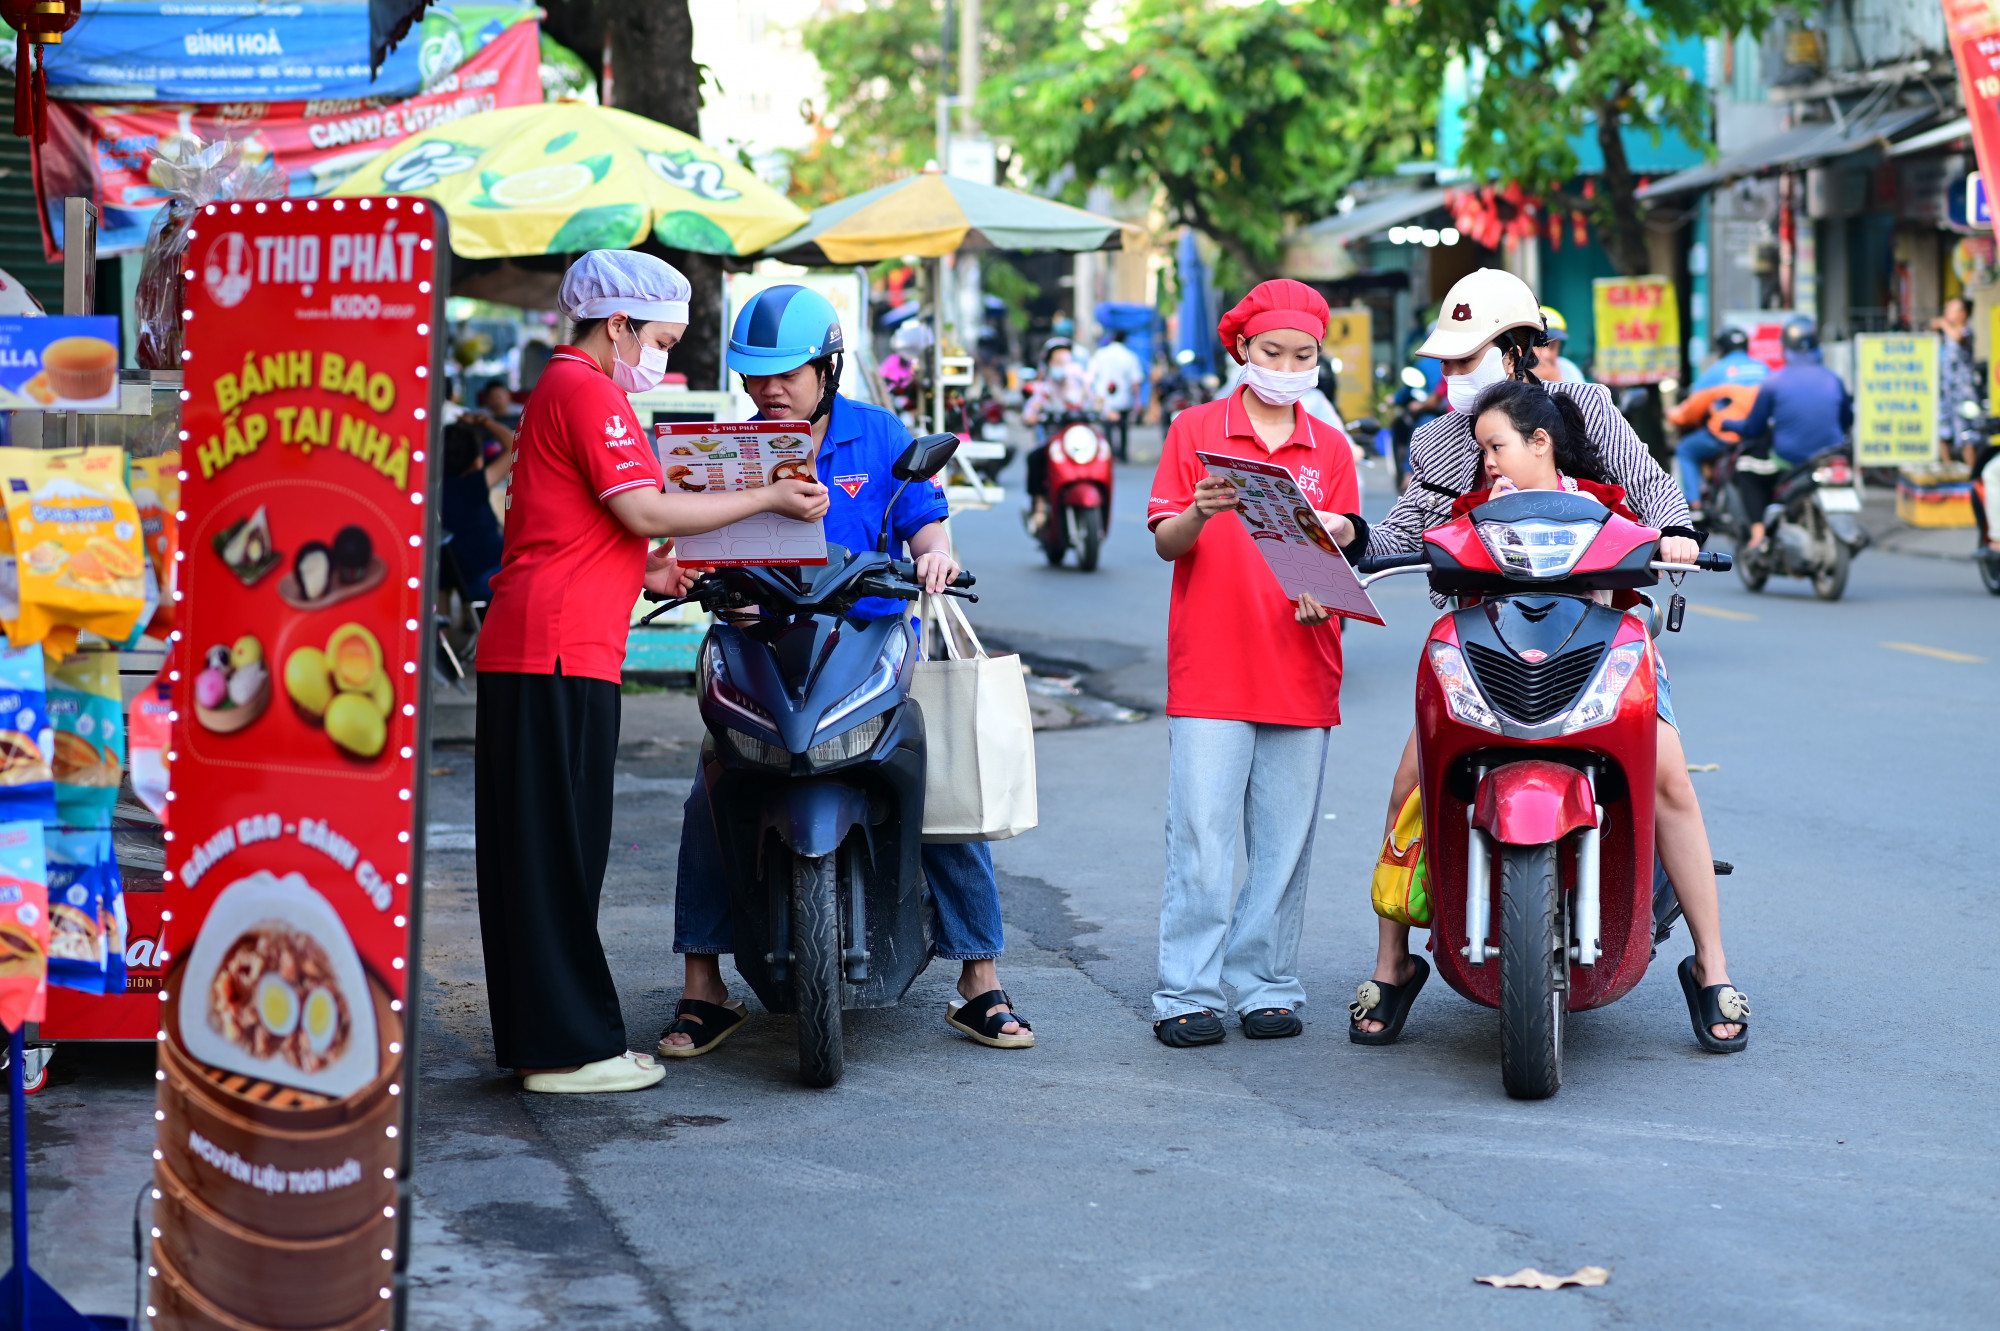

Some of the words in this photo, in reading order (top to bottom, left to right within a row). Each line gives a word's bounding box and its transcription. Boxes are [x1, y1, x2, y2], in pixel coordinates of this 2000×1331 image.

[184, 28, 235, 55] BÌNH
[382, 109, 402, 138] &
[254, 235, 321, 298] THỌ
[329, 217, 420, 283] PHÁT
[330, 293, 382, 319] KIDO
[213, 349, 313, 415] BÁNH
[319, 351, 396, 413] BAO
[196, 405, 269, 480] HẤP
[274, 405, 333, 455] TẠI
[336, 412, 411, 491] NHÀ
[619, 436, 636, 447] PHÁT
[615, 460, 635, 471] KIDO
[1300, 465, 1320, 480] mini
[125, 975, 153, 988] GIÒN
